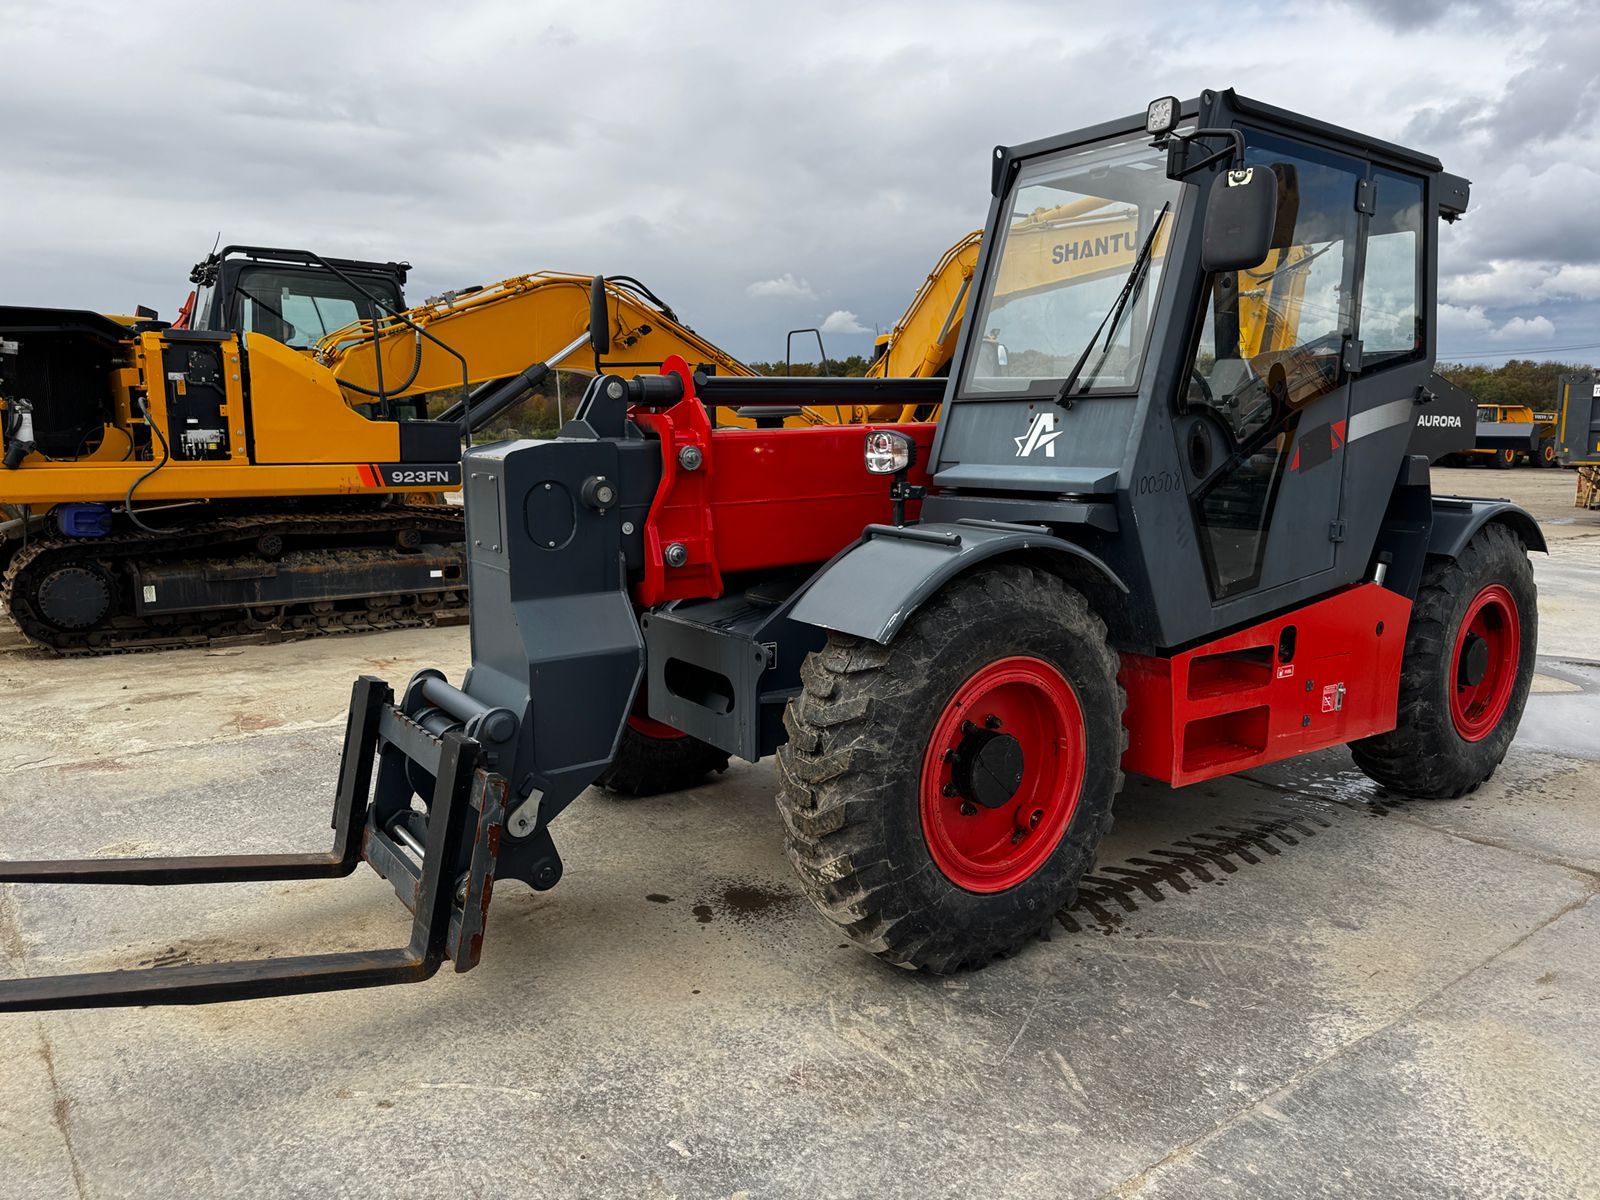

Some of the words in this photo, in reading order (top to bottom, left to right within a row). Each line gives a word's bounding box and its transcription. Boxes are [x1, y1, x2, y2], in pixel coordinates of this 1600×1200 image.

[1417, 415, 1461, 428] AURORA
[391, 471, 449, 483] 923FN
[1135, 470, 1181, 497] 100508
